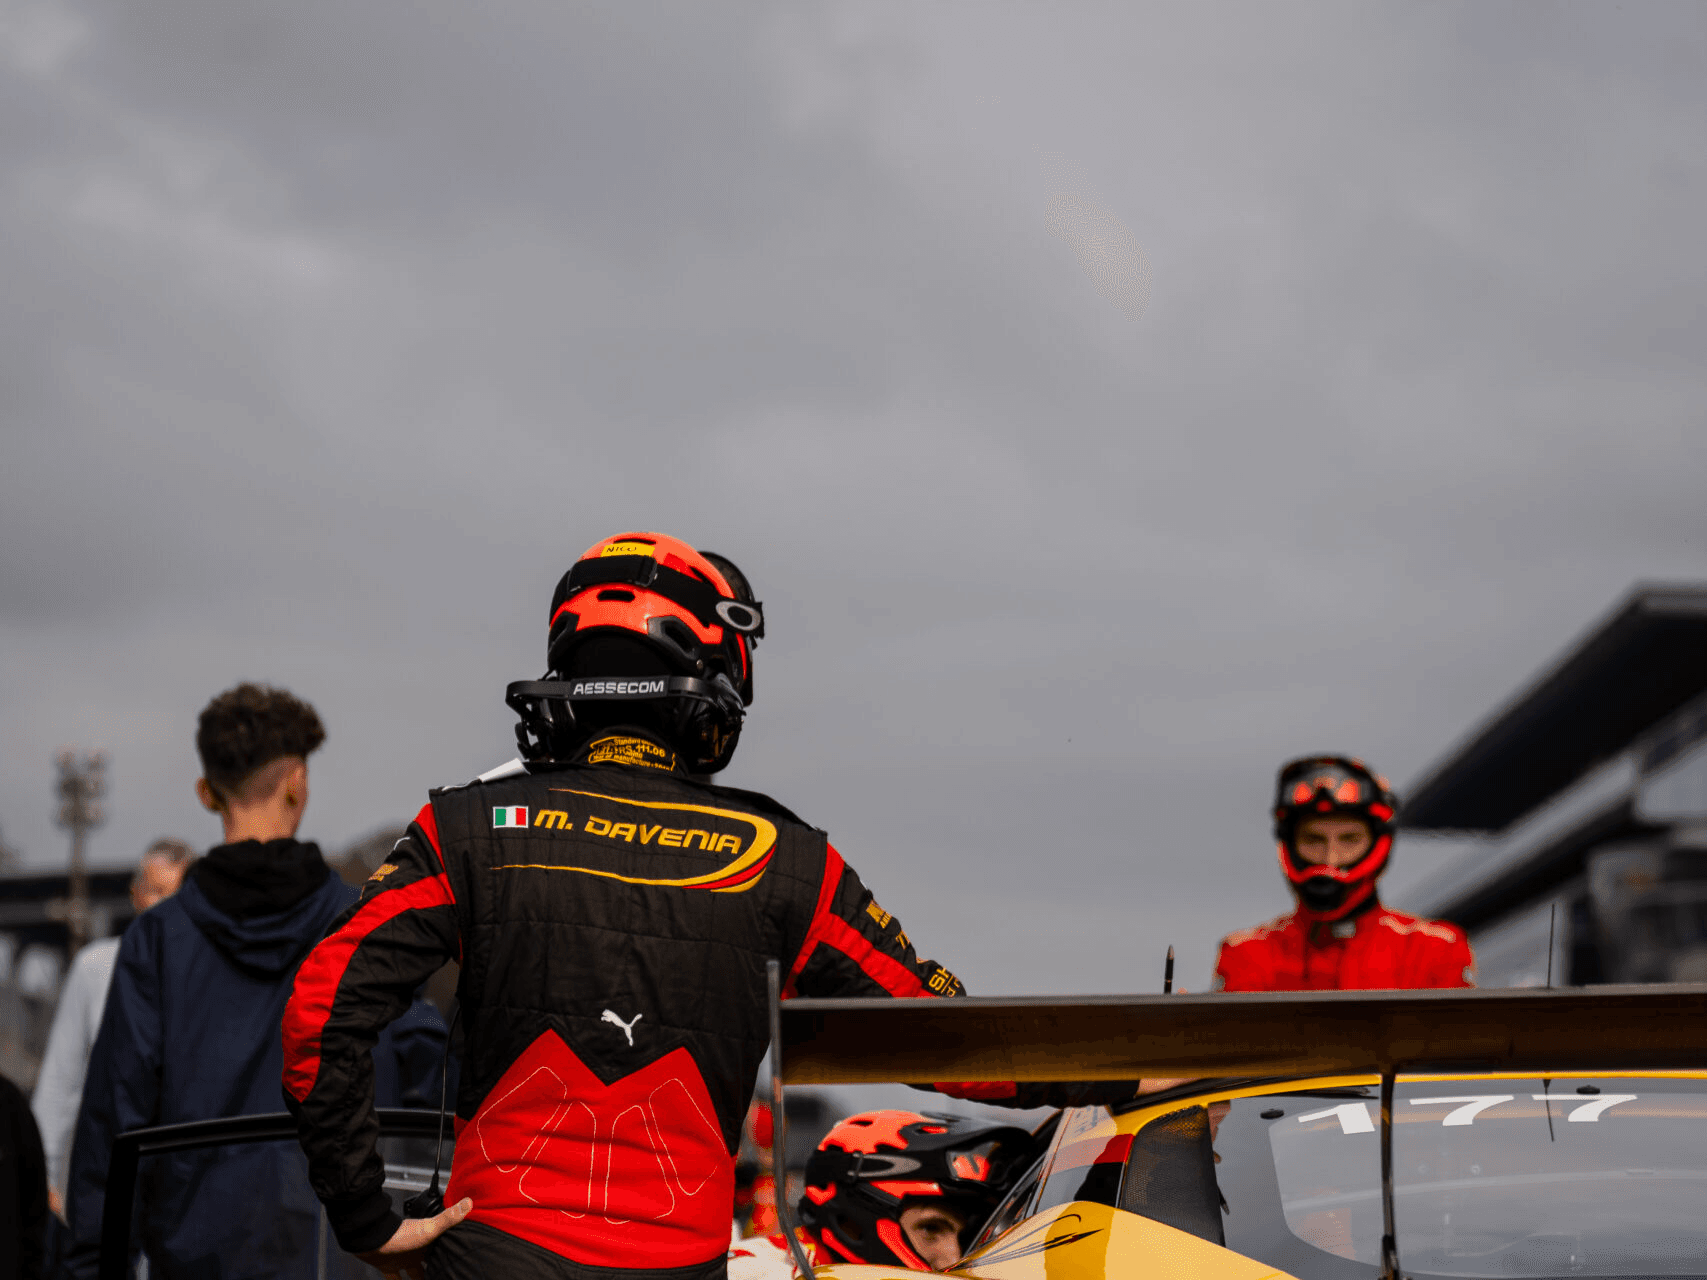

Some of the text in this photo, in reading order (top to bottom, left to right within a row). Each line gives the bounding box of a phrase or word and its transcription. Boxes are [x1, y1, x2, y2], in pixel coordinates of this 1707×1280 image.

[573, 680, 665, 695] AESSECOM
[534, 809, 743, 855] M. DAVENIA
[1298, 1094, 1638, 1135] 177
